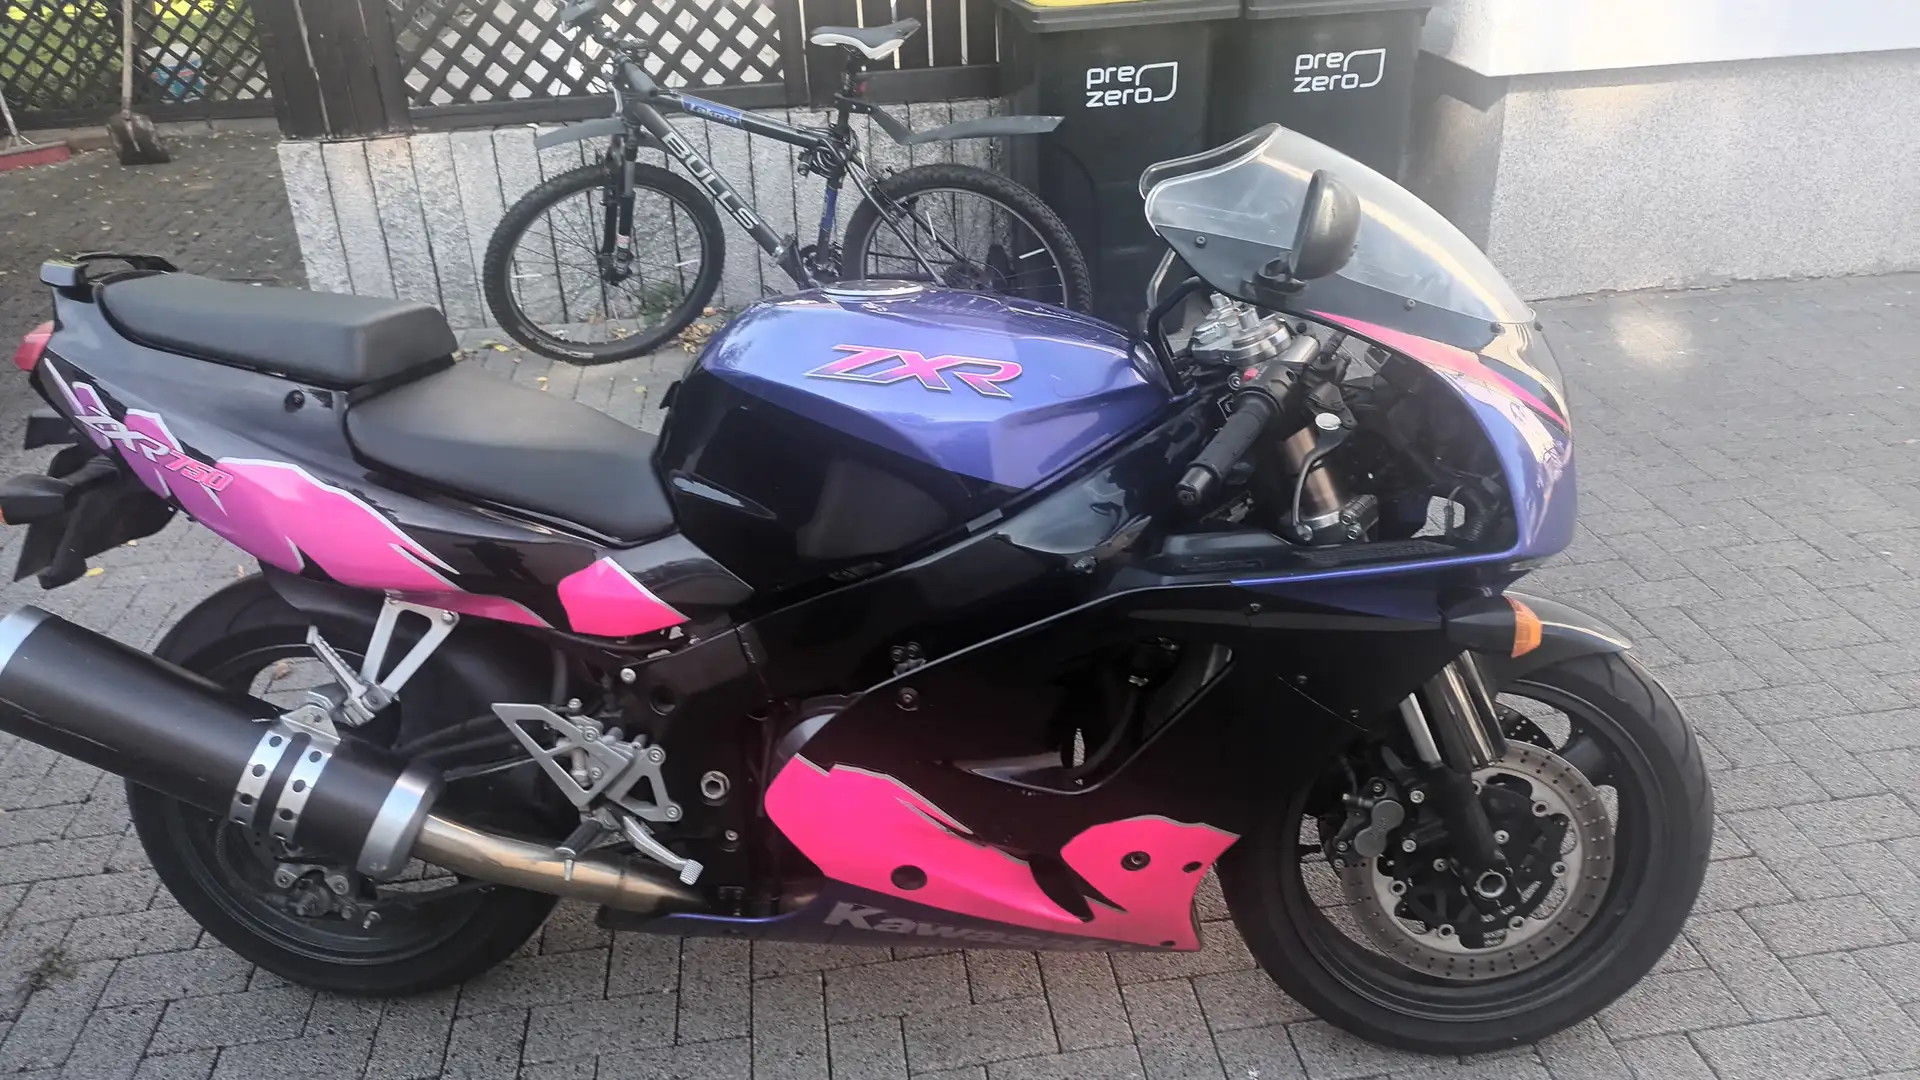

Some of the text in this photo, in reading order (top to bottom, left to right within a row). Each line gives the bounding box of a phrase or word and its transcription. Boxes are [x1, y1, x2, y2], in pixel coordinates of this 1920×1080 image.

[1295, 52, 1344, 74] pre
[1087, 65, 1135, 89] pre
[1293, 73, 1359, 92] zero
[1086, 86, 1152, 108] zero
[662, 131, 759, 230] BULLS
[802, 343, 1022, 398] ZXR
[74, 405, 234, 492] ZXR 750
